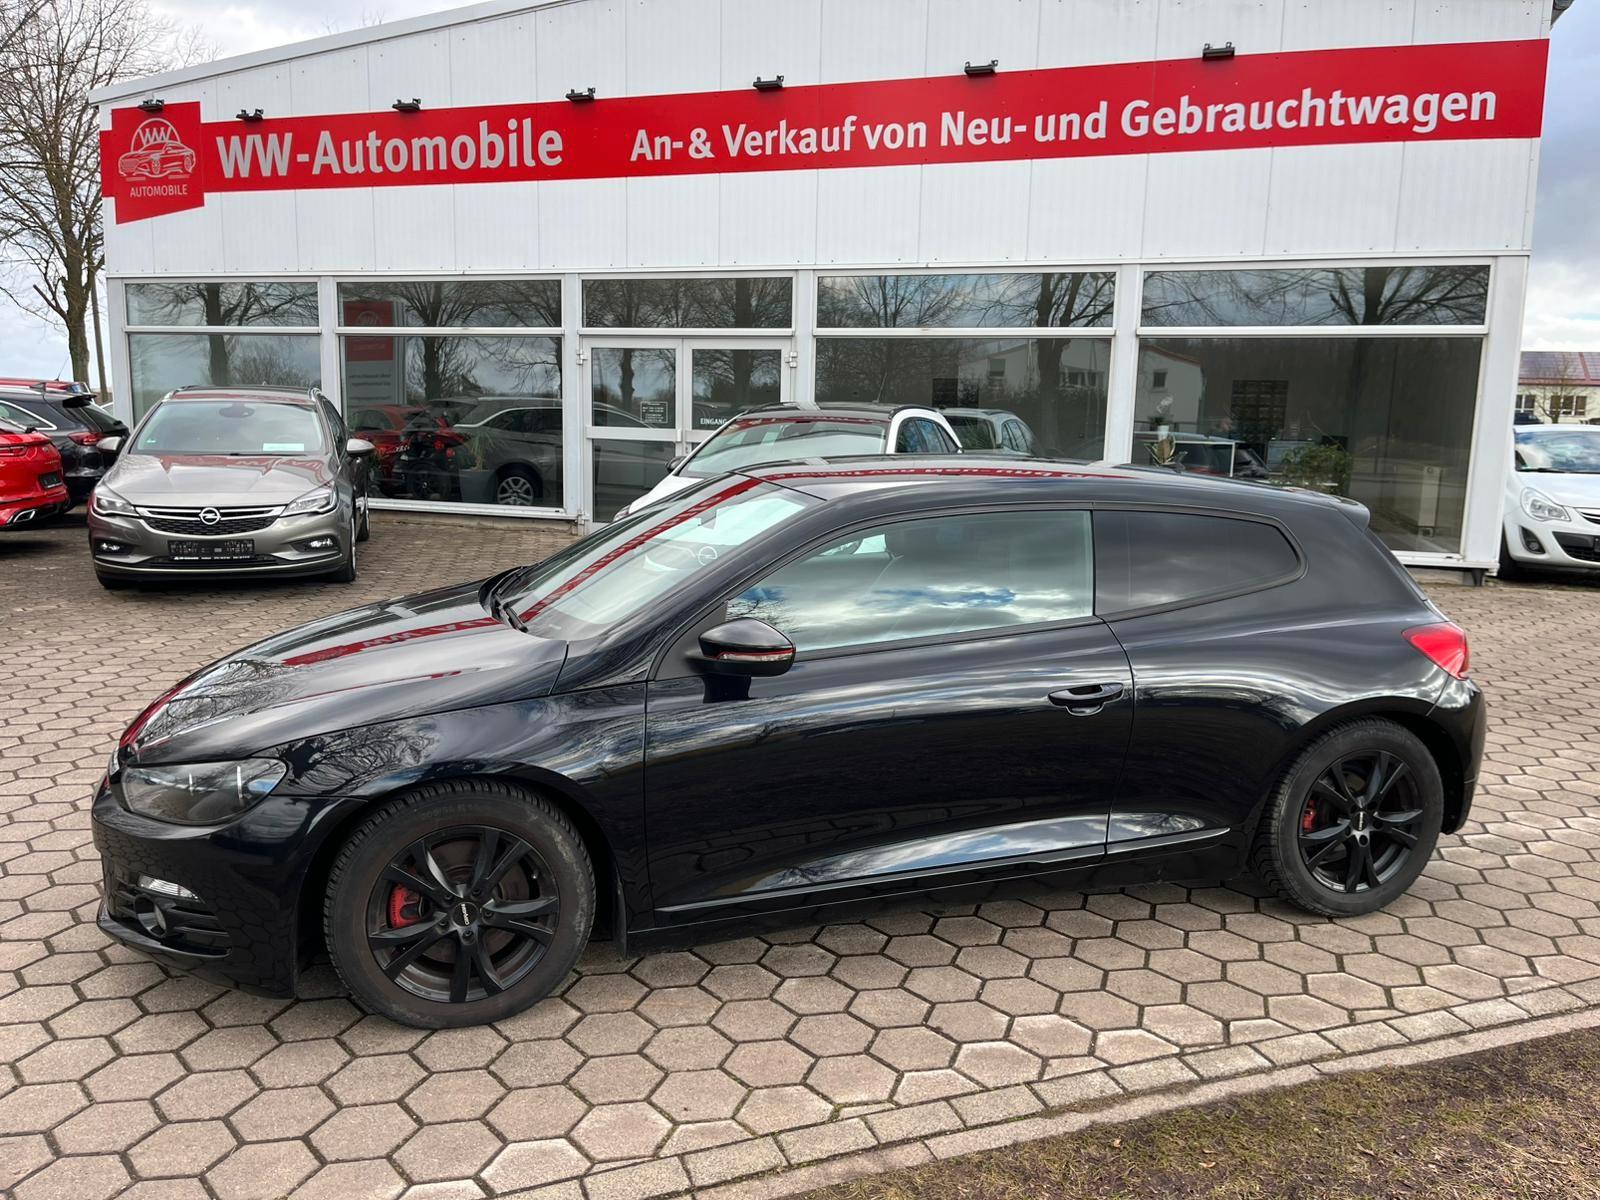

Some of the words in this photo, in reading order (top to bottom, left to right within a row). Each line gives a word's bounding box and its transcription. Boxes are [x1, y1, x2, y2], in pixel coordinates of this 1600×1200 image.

[215, 117, 563, 179] WW-Automobile
[630, 129, 684, 162] An-
[688, 127, 715, 159] &
[721, 116, 857, 157] Verkauf
[862, 121, 927, 150] von
[940, 111, 1027, 147] Neu-
[1034, 101, 1108, 142] und
[1120, 87, 1497, 134] Gebrauchtwagen
[130, 184, 188, 198] AUTOMOBILE
